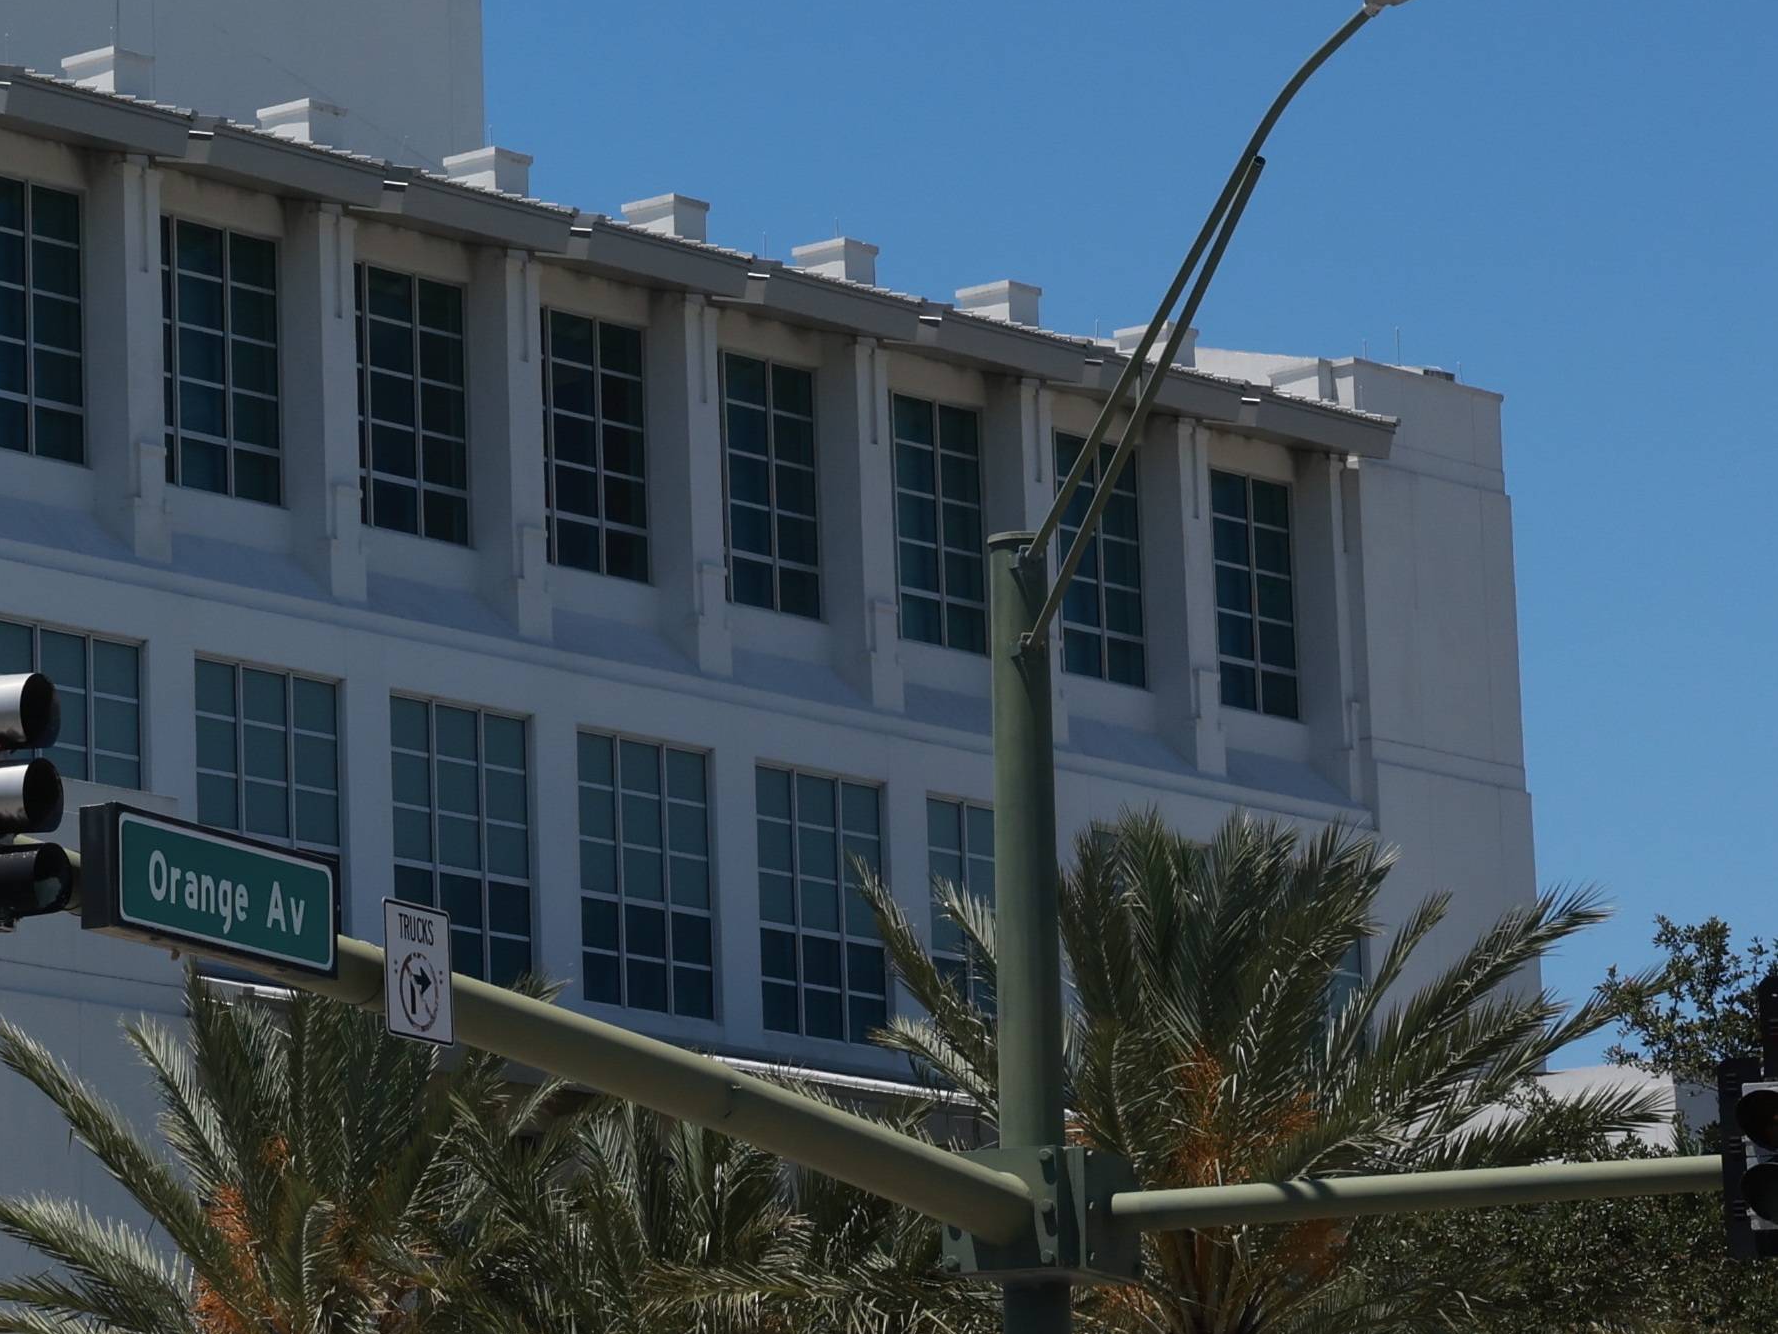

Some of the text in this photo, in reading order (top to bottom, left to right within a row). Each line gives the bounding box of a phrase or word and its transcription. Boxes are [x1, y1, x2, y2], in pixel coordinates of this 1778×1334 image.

[148, 849, 306, 936] Orange Av
[398, 912, 435, 947] TRUCKS
